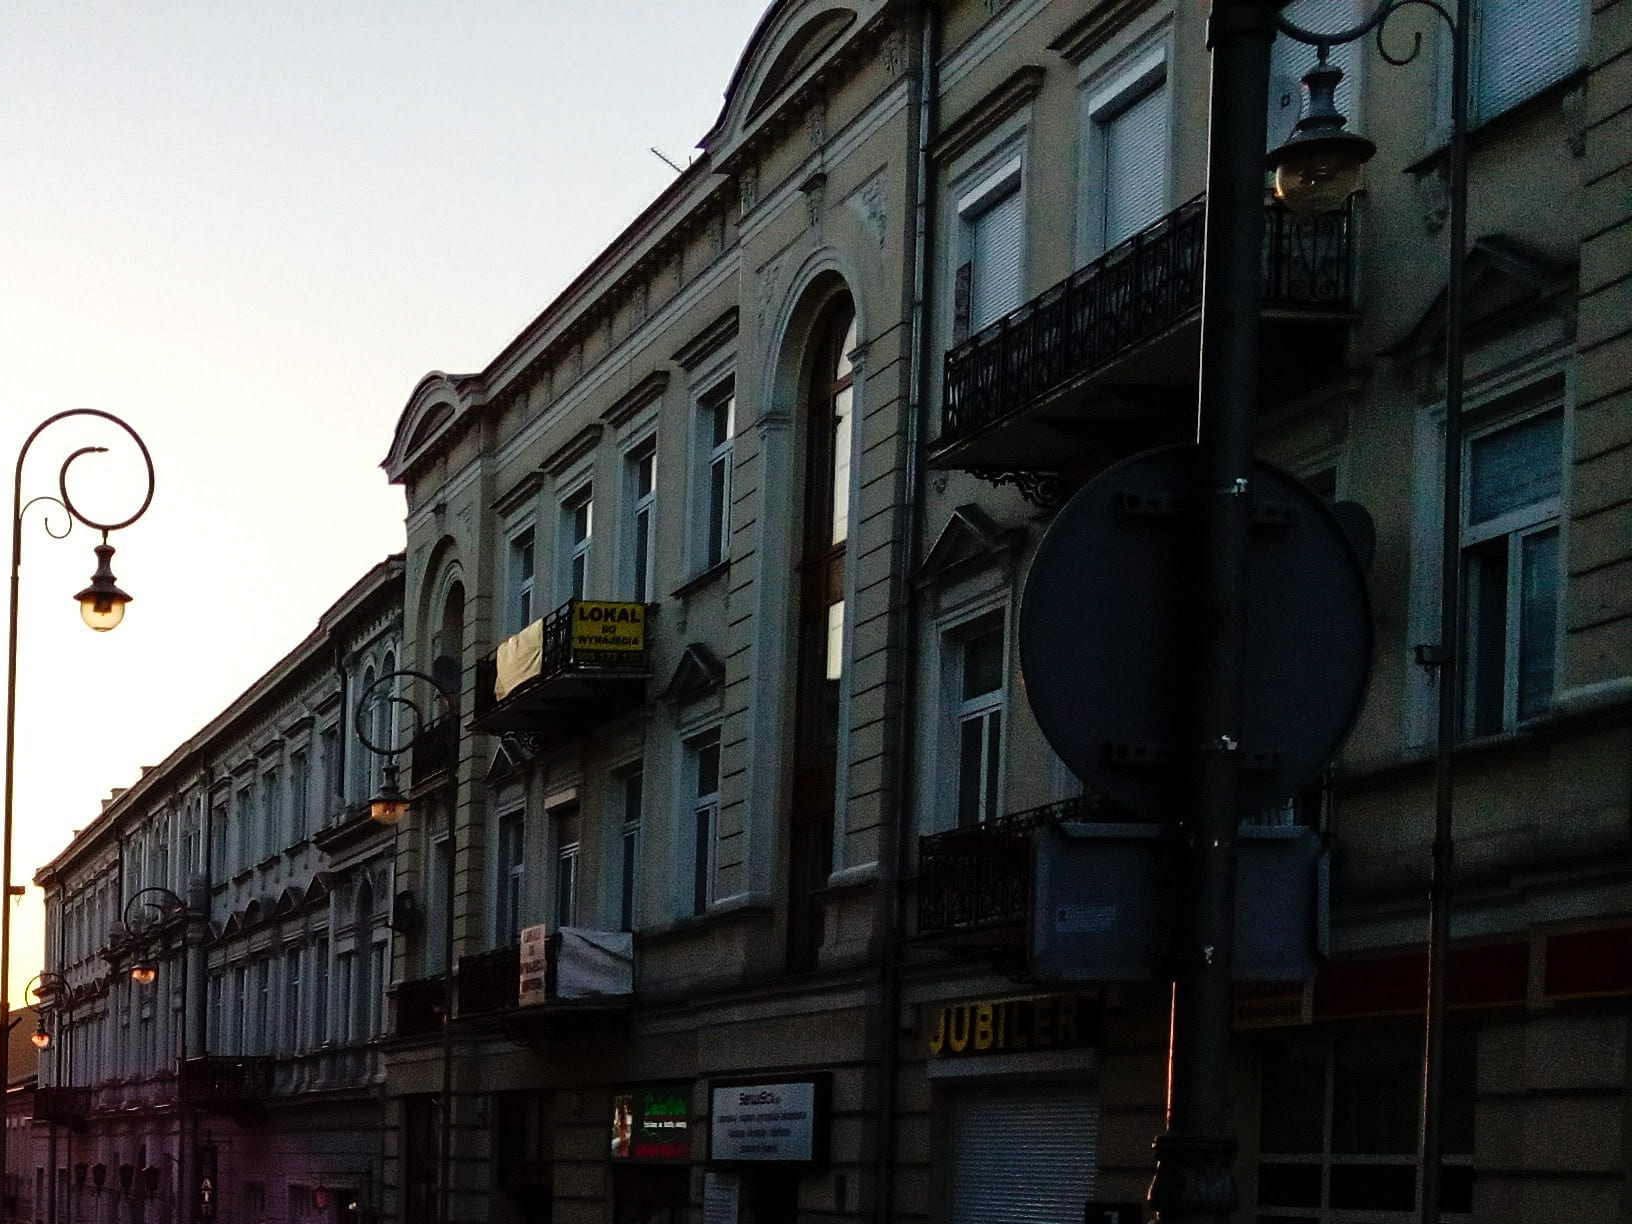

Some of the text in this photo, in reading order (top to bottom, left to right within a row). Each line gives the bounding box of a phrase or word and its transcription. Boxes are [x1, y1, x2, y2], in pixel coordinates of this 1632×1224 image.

[579, 606, 641, 623] LOKAL
[601, 624, 616, 634] DO
[927, 999, 1079, 1055] JUBILER
